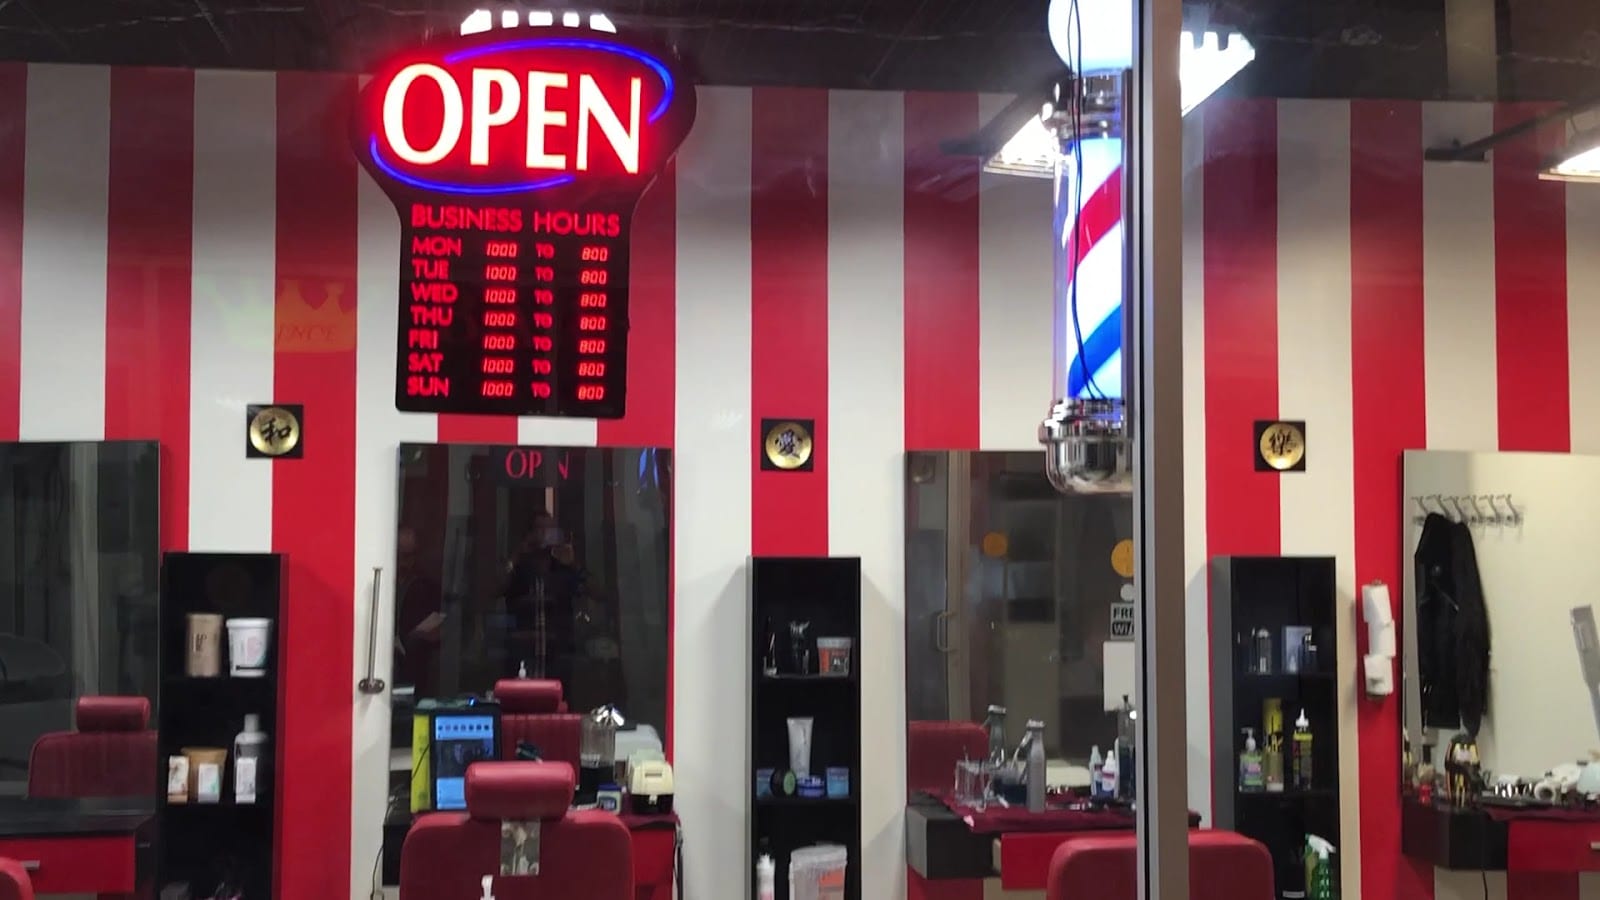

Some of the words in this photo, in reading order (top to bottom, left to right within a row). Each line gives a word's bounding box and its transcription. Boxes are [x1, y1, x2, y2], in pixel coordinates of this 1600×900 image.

[383, 63, 642, 174] OPEN
[411, 203, 523, 232] BUSINESS
[533, 210, 621, 237] HOURS
[412, 236, 462, 257] MON
[485, 240, 518, 258] 1000
[535, 242, 555, 259] TO
[581, 245, 609, 262] 800
[412, 258, 449, 280] TUE
[485, 264, 518, 282] 1000
[535, 266, 554, 281] TO
[580, 268, 608, 285] 800
[411, 282, 458, 303] WED
[484, 287, 517, 304] 1000
[534, 289, 554, 305] TO
[580, 292, 607, 308] 800
[410, 305, 453, 326] THU
[484, 311, 516, 327] 1000
[533, 312, 553, 328] TO
[579, 315, 607, 331] 800
[409, 329, 439, 349] FRI
[483, 334, 516, 350] 1000
[533, 336, 553, 351] TO
[578, 338, 606, 354] 800
[408, 352, 444, 372] SAT
[482, 357, 515, 374] 1000
[532, 359, 552, 374] TO
[578, 361, 605, 377] 800
[407, 375, 450, 396] SUN
[482, 380, 514, 397] 1000
[531, 382, 551, 398] TO
[577, 384, 605, 401] 800
